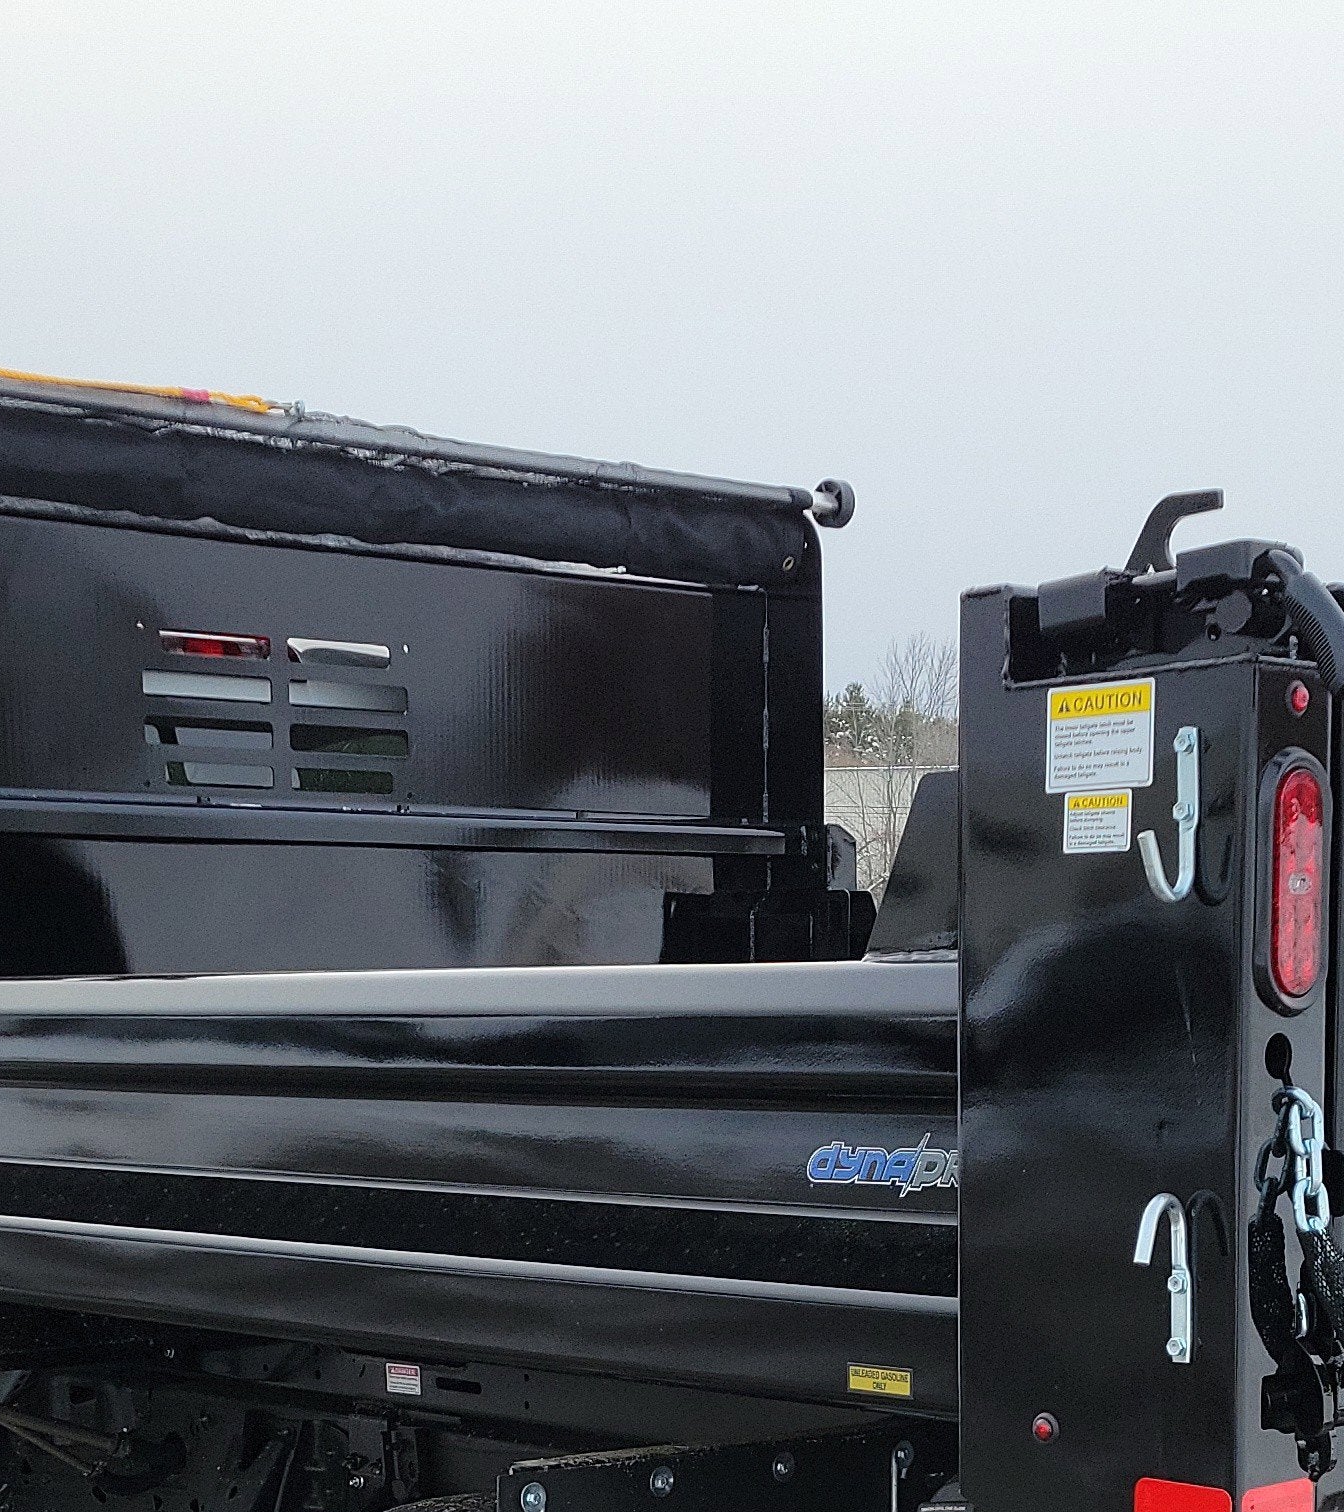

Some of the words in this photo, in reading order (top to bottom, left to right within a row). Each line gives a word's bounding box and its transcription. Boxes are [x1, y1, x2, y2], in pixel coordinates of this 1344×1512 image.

[1074, 690, 1142, 713] CAUTION
[1082, 796, 1123, 808] CAUTION
[851, 1368, 880, 1380] UNLEADED
[881, 1371, 909, 1383] GASOLINE
